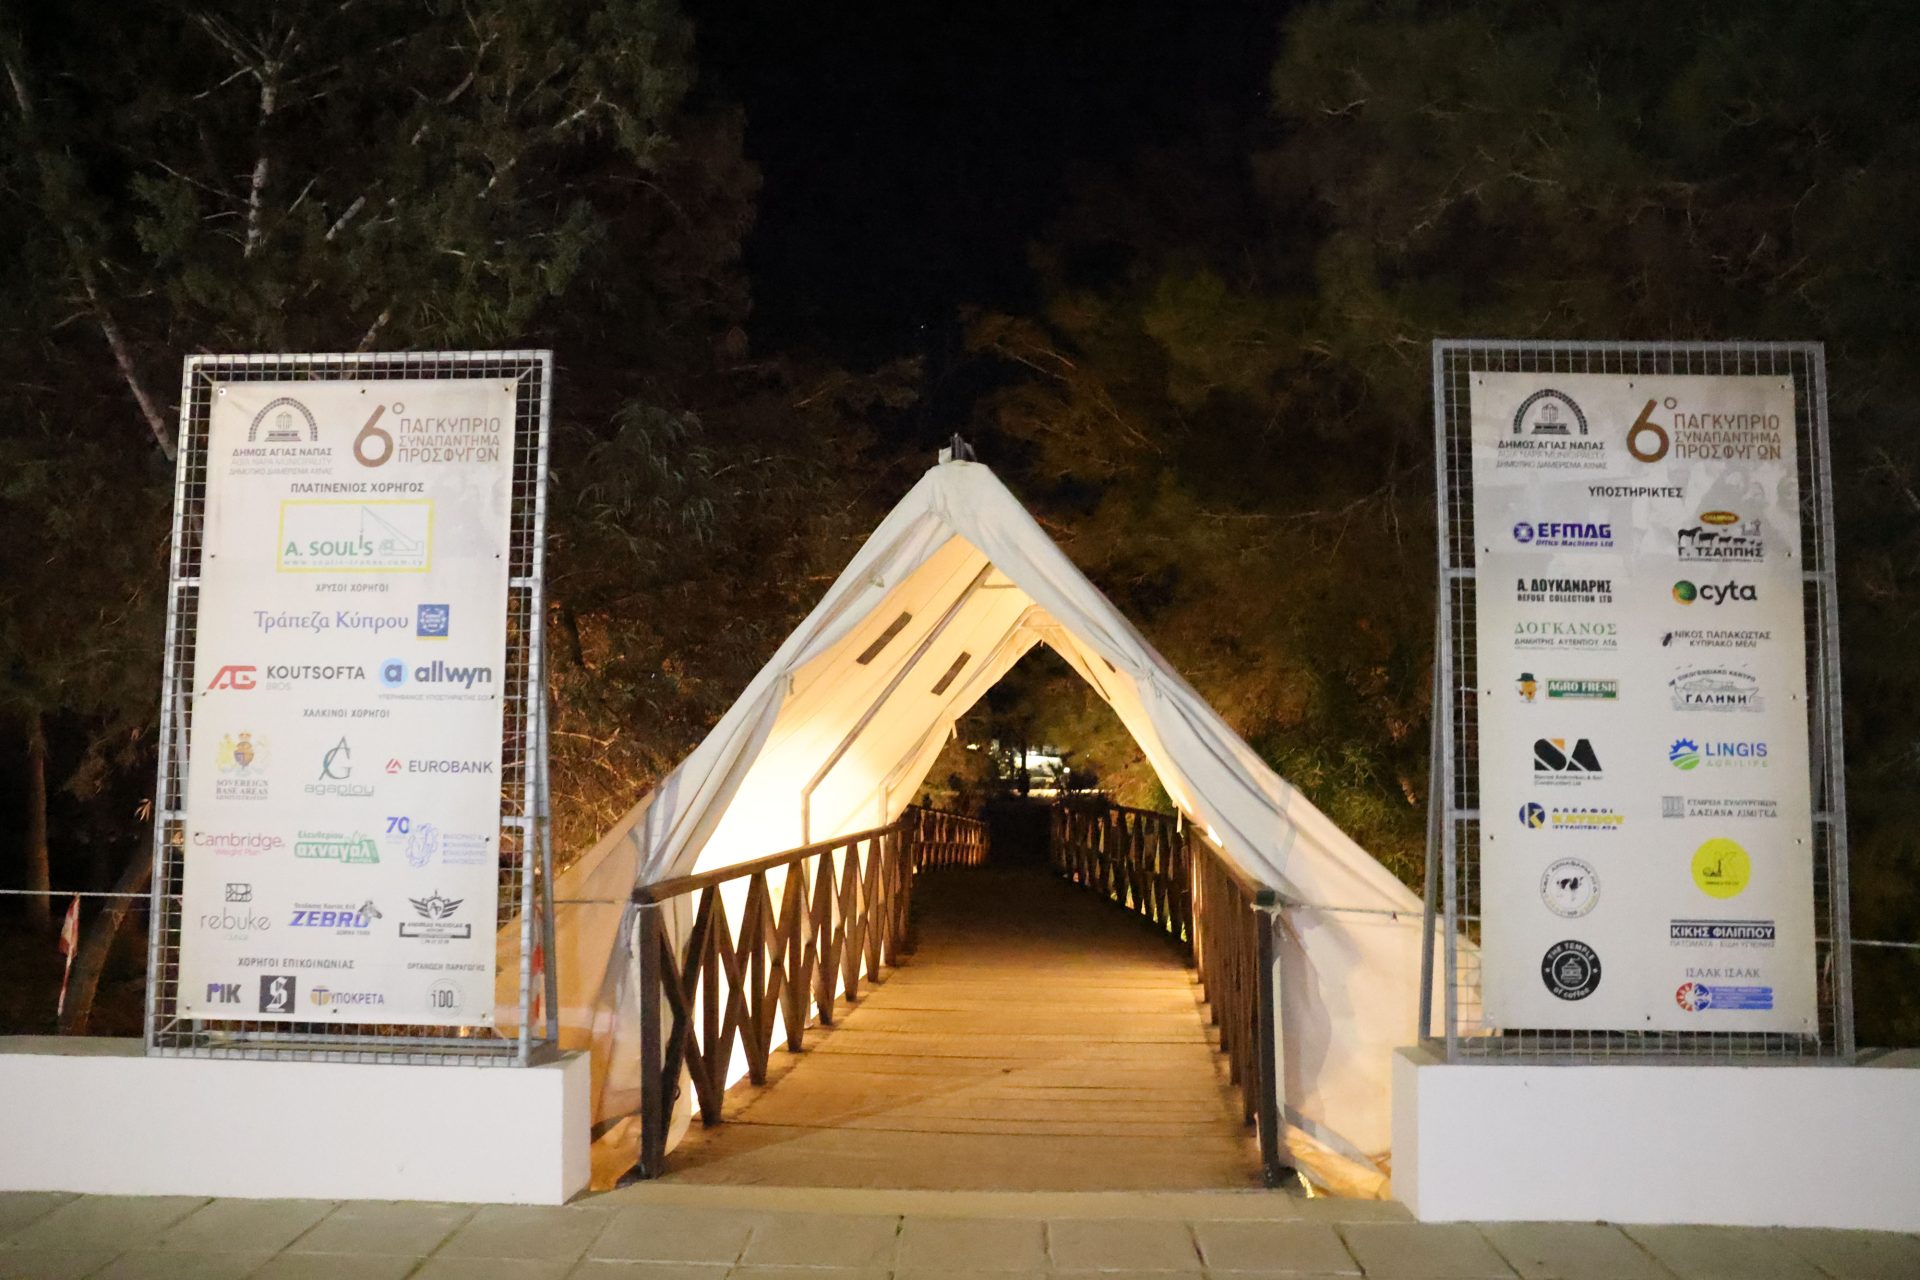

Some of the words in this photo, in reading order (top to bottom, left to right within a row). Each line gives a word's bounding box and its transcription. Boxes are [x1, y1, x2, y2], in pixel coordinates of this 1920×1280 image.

[400, 417, 500, 434] ΠΑΓΚΥΠΡΙΟ
[1674, 414, 1780, 431] ΠΑΓΚΥΠΡΙΟ
[399, 434, 500, 448] ΣΥΝΑΠΑΝΤΗΜΑ
[1674, 430, 1780, 444] ΣΥΝΑΠΑΝΤΗΜΑ
[232, 448, 267, 456] ΔΗΜΟΣ
[269, 448, 297, 456] ΑΓΙΑΣ
[299, 447, 332, 456] ΝΑΠΑΣ
[1498, 440, 1535, 449] ΔΗΜΟΣ
[1537, 441, 1567, 450] ΑΓΙΑΣ
[1569, 441, 1605, 450] ΝΑΠΑΣ
[1675, 443, 1781, 460] ΠΡΟΣΦΥΓΩΝ
[398, 446, 500, 463] ΠΡΟΣΦΥΓΩΝ
[290, 483, 368, 494] ΠΛΑΤΙΝΕΝΙΟΣ
[370, 483, 425, 494] ΧΟΡΗΓΟΣ
[1588, 486, 1684, 499] ΥΠΟΣΤΗΡΙΚΤΕΣ
[1538, 523, 1611, 539] EFMAG
[284, 541, 304, 556] A.
[1695, 547, 1764, 558] ΤΣΑΠΠΗΣ
[315, 584, 347, 593] ΧΡΥΣΟΙ
[350, 584, 389, 593] ΧΟΡΗΓΟΙ
[1531, 578, 1612, 593] ΔΟΥΚΑΝΑΡΗΣ
[1549, 594, 1595, 603] COLLECTION
[1699, 580, 1758, 606] cyta
[254, 611, 330, 634] Τράπεζα
[336, 611, 409, 634] Κύπρου
[1514, 621, 1617, 636] ΔΟΓΚΑΝΟΣ
[1674, 630, 1704, 639] ΝΙΚΟΣ
[266, 665, 366, 680] KOUTSOFTA
[414, 660, 492, 690] allwyn
[1685, 694, 1747, 704] ΓΑΛΗΝΗ
[303, 708, 348, 718] ΧΑΛΚΙΝΟΙ
[351, 708, 390, 718] ΧΟΡΗΓΟΙ
[1705, 742, 1768, 758] LINGIS
[408, 760, 493, 774] EUROBANK
[386, 816, 410, 834] 70
[193, 832, 282, 851] Cambridge
[200, 907, 272, 931] rebuke
[1672, 926, 1710, 938] ΚΙΚΗΣ
[1712, 927, 1773, 938] ΦΙΛΙΠΠΟΥ
[237, 957, 279, 968] ΧΟΡΗΓΟΙ
[282, 959, 355, 969] ΕΠΙΚΟΙΝΩΝΙΑΣ
[1686, 968, 1721, 978] ΙΣΑΑΚ
[1724, 968, 1761, 978] ΙΣΑΑΚ
